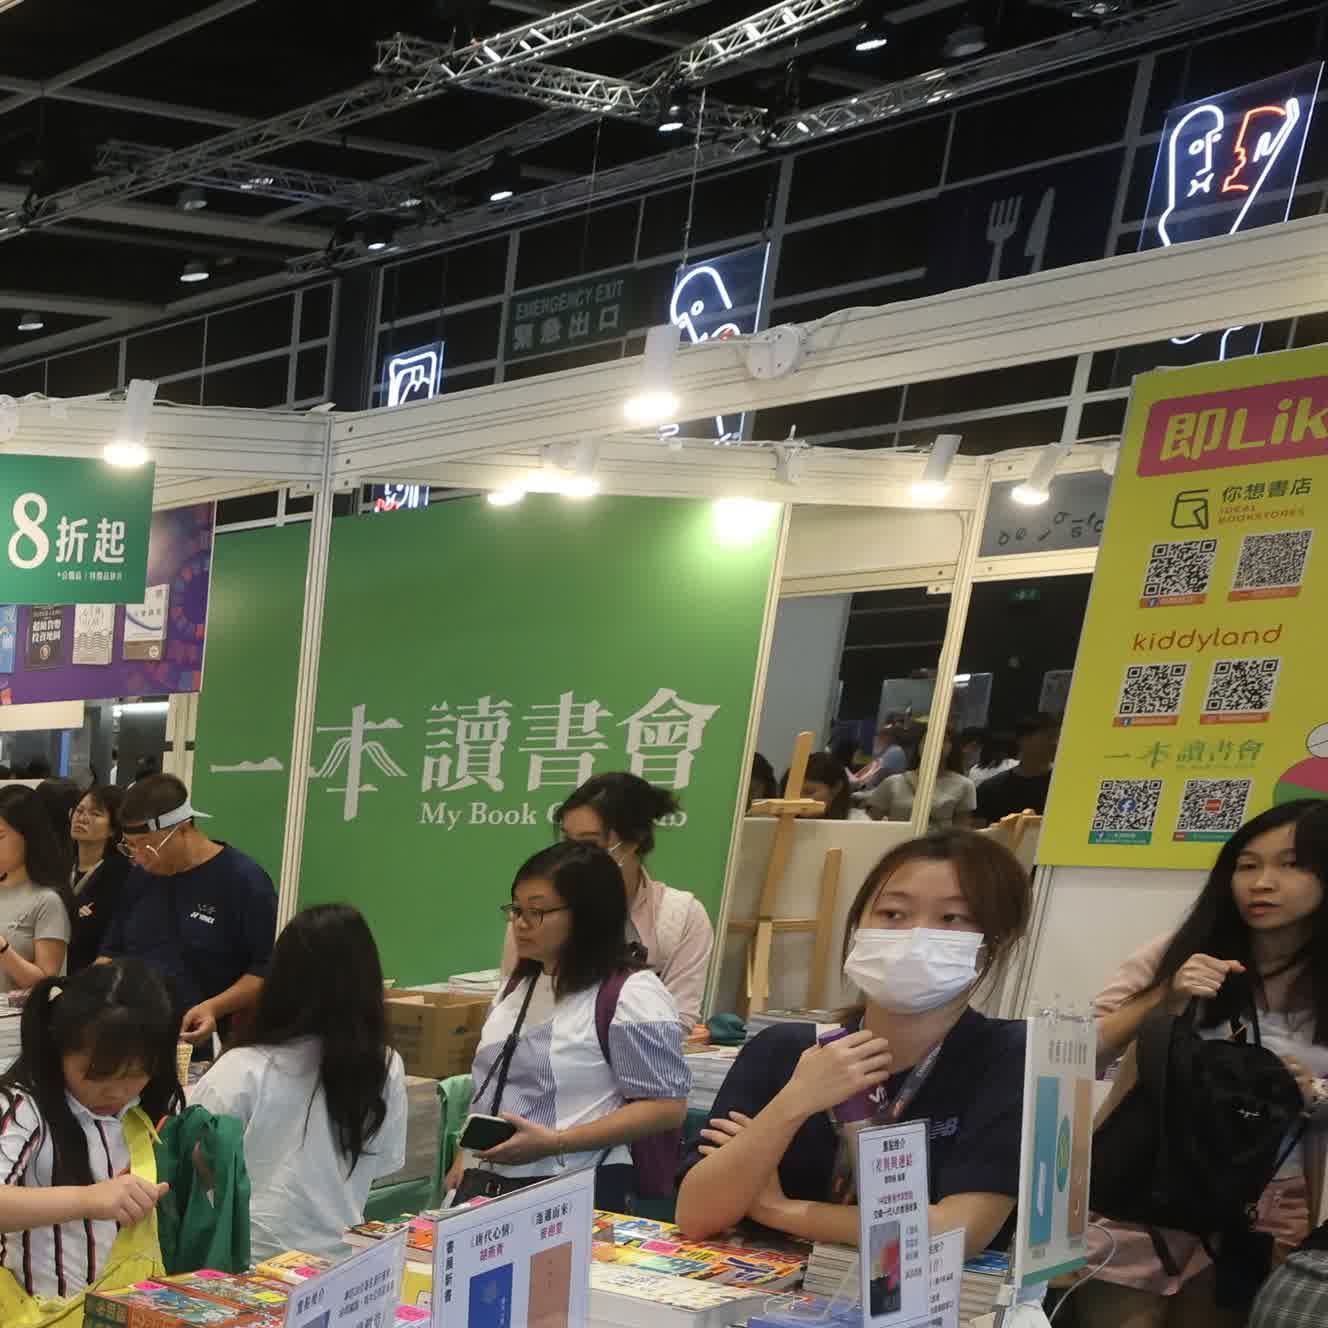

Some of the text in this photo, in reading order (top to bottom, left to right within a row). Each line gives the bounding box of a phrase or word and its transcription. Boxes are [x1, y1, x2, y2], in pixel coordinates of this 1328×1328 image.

[1221, 477, 1313, 504] 你想書店
[1132, 624, 1283, 653] kiddyland
[209, 688, 721, 822] 一本讀書會
[420, 803, 461, 831] My
[469, 803, 537, 825] Book
